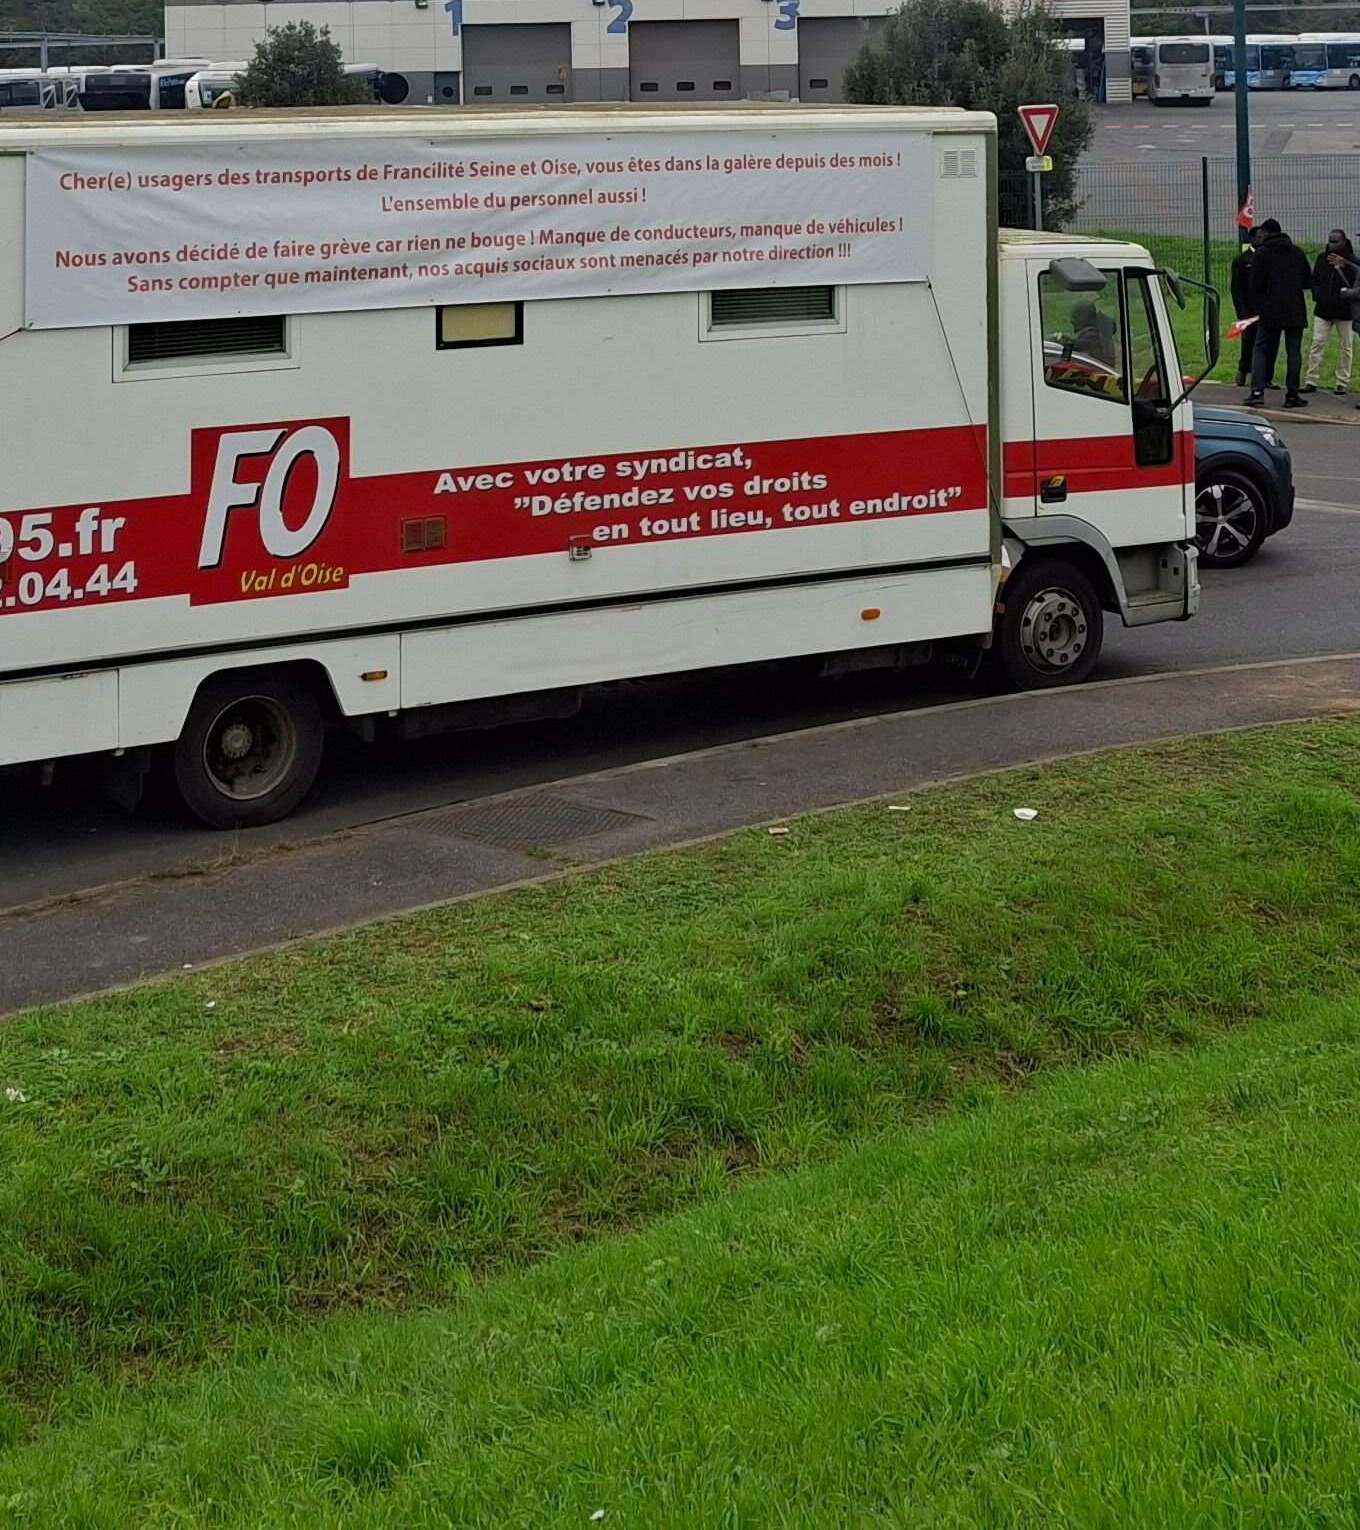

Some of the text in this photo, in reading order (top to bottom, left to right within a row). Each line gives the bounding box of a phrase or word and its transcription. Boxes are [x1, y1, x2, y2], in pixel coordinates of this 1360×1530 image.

[60, 172, 131, 191] Cher(e)
[139, 174, 213, 191] usagers
[217, 169, 250, 185] des
[256, 167, 351, 186] transports
[356, 164, 378, 181] de
[384, 162, 464, 180] Francilité
[470, 161, 516, 177] Seine
[520, 162, 536, 175] et
[541, 159, 580, 175] Oise,
[586, 162, 624, 173] vous
[628, 157, 661, 172] êtes
[665, 156, 702, 171] dans
[707, 155, 719, 170] la
[724, 155, 772, 174] galère
[776, 153, 826, 172] depuis
[829, 153, 855, 167] des
[859, 152, 893, 166] mois
[382, 193, 479, 211] L'ensemble
[484, 192, 506, 208] du
[510, 189, 592, 211] personnel
[597, 188, 637, 204] aussi
[56, 251, 107, 268] Nous
[112, 251, 170, 265] avons
[176, 243, 240, 262] décidé
[245, 242, 268, 259] de
[273, 241, 315, 257] faire
[320, 238, 371, 259] grève
[376, 241, 402, 252] car
[408, 235, 440, 251] rien
[446, 237, 466, 249] ne
[471, 232, 525, 250] bouge
[539, 230, 606, 247] Manque
[610, 226, 630, 241] de
[634, 225, 736, 240] conducteurs,
[741, 224, 802, 238] manque
[806, 219, 824, 234] de
[829, 217, 895, 233] véhicules
[128, 276, 173, 292] Sans
[178, 273, 260, 292] compter
[264, 272, 300, 289] que
[305, 263, 412, 283] maintenant,
[418, 264, 449, 276] nos
[455, 258, 509, 278] acquis
[512, 255, 575, 272] sociaux
[580, 254, 616, 268] sont
[621, 249, 688, 267] menacés
[693, 252, 718, 267] par
[723, 248, 764, 262] notre
[769, 244, 834, 260] direction
[433, 447, 752, 495] Avec votre syndicat,
[683, 482, 735, 501] vos
[743, 471, 828, 496] droits
[198, 425, 340, 569] FO
[592, 523, 629, 542] en
[640, 512, 701, 537] tout
[711, 509, 772, 529] lieu,
[782, 498, 841, 522] tout
[241, 562, 344, 593] Val d'Oise
